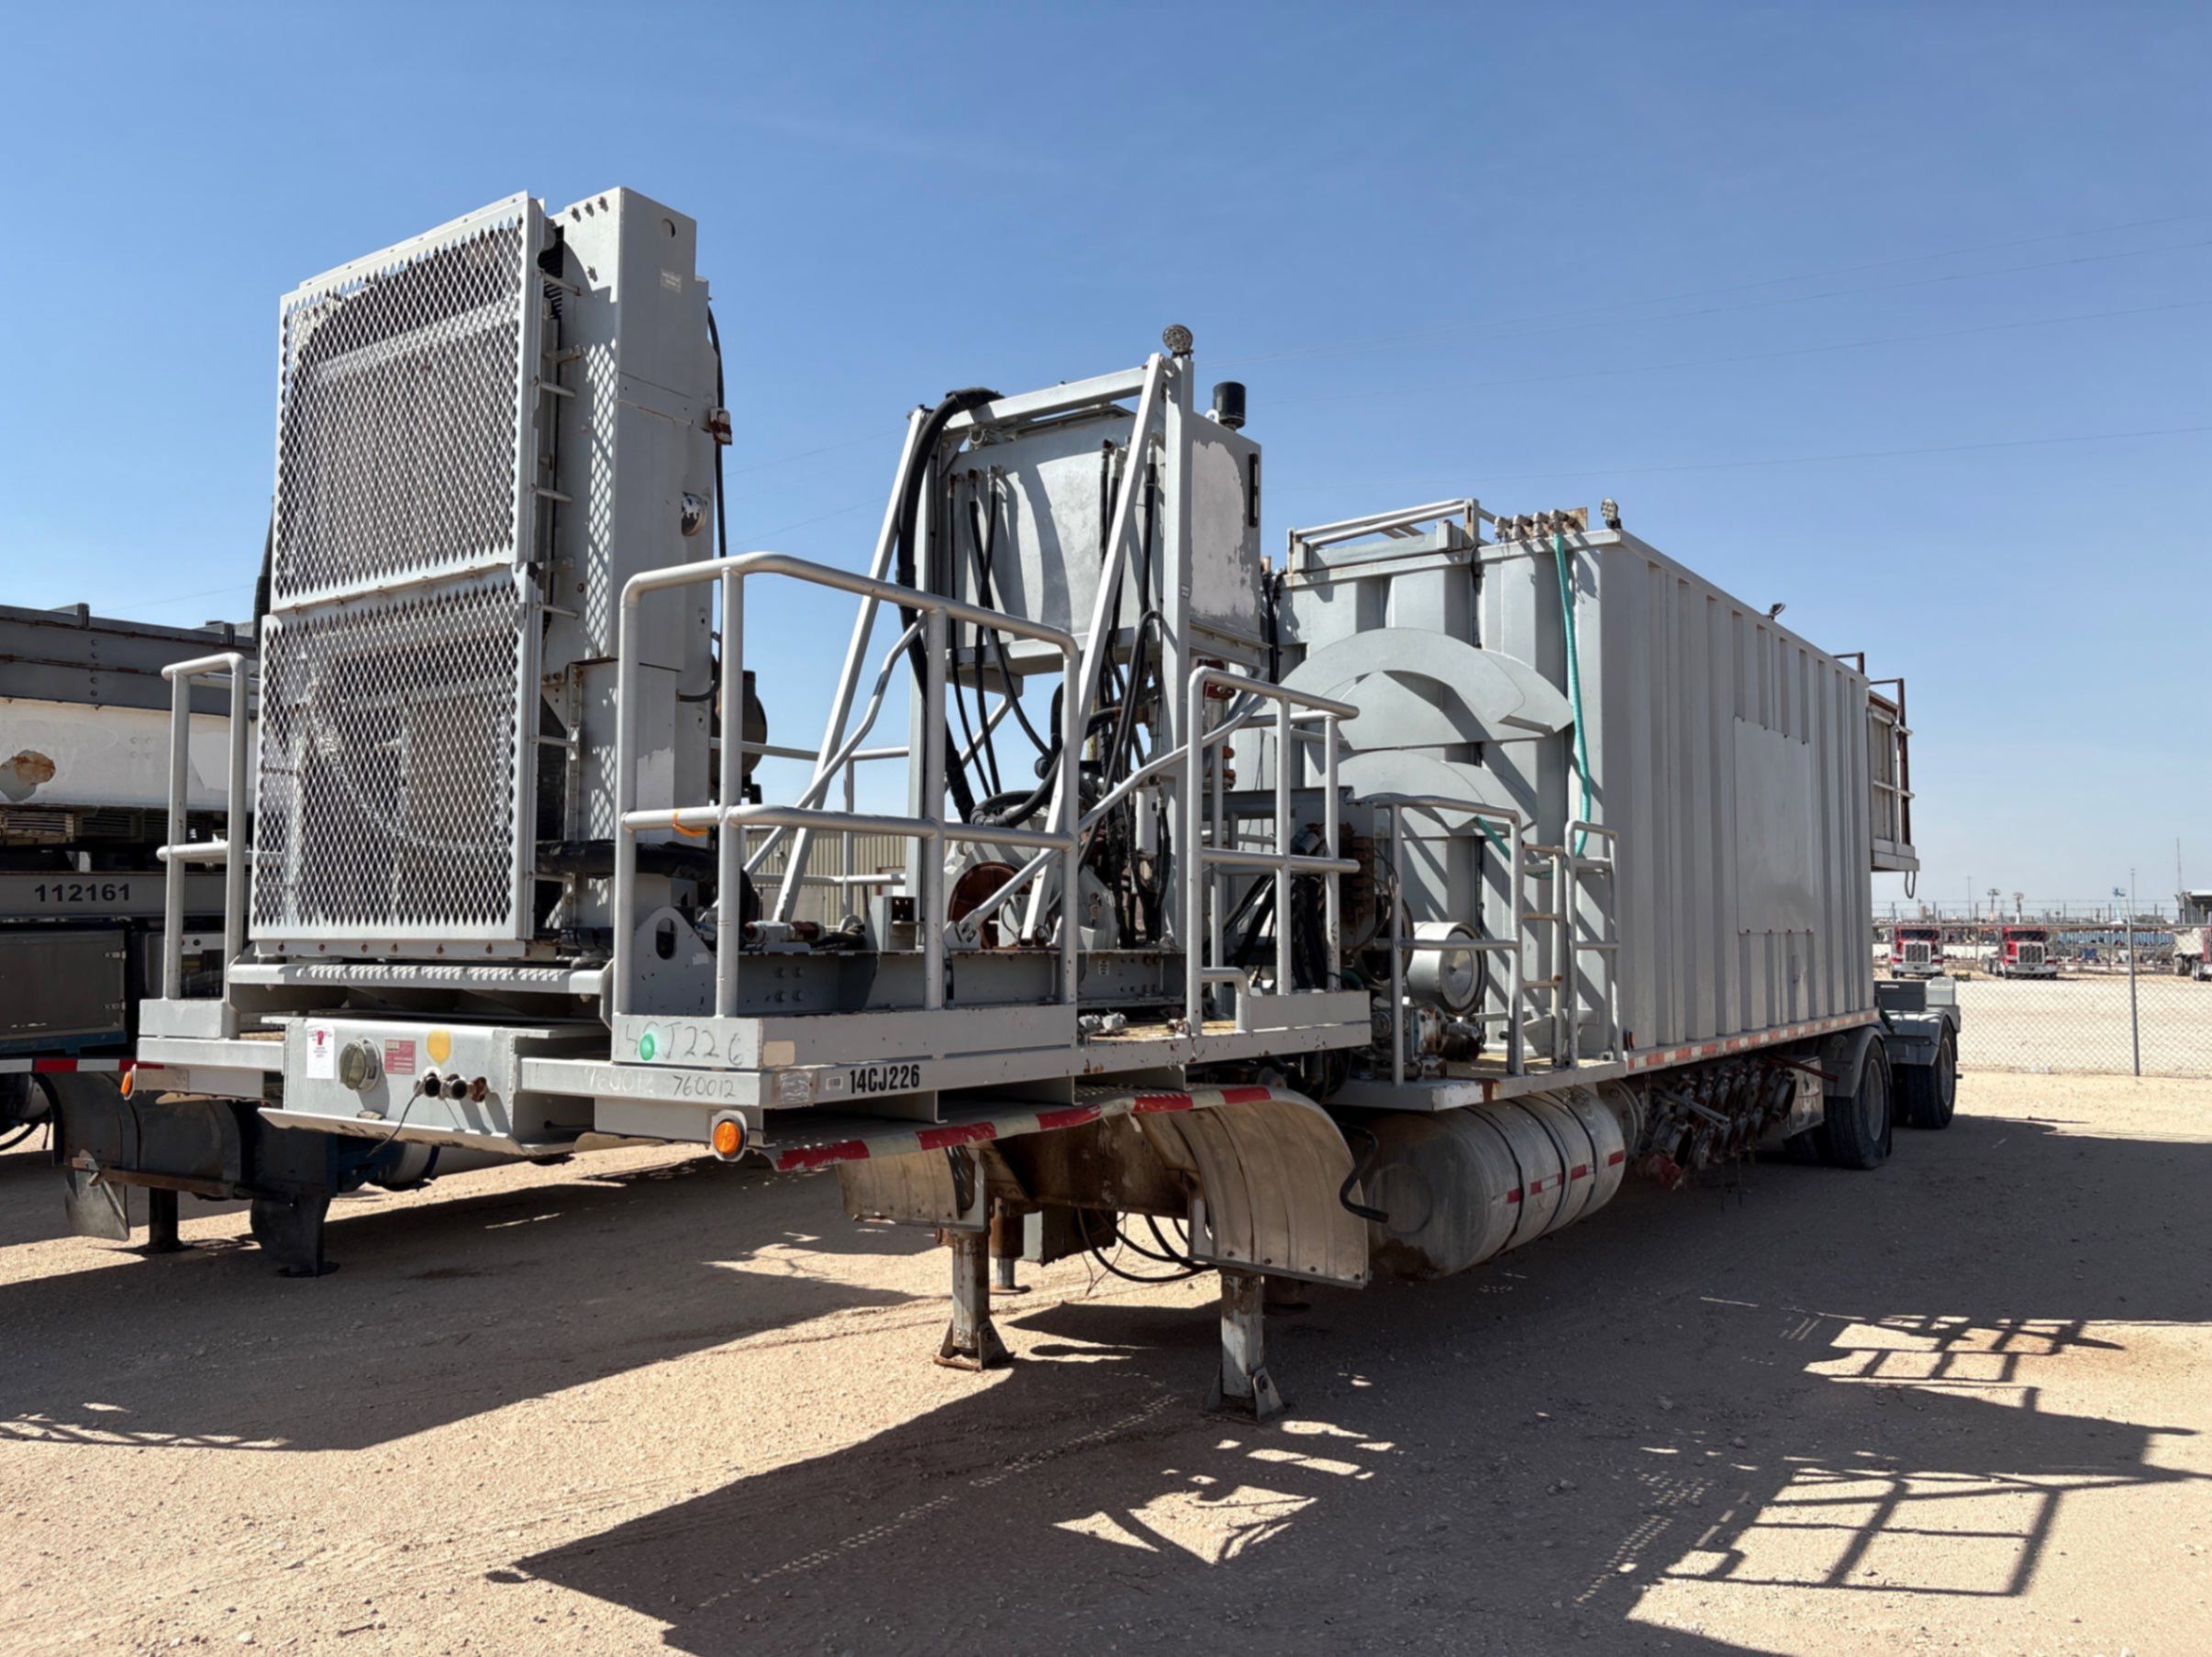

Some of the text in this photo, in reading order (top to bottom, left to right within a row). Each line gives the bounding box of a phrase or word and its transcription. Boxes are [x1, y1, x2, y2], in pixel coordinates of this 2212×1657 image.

[35, 884, 129, 902] 112161
[672, 1074, 736, 1097] 760012
[850, 1064, 920, 1094] 14CJ226
